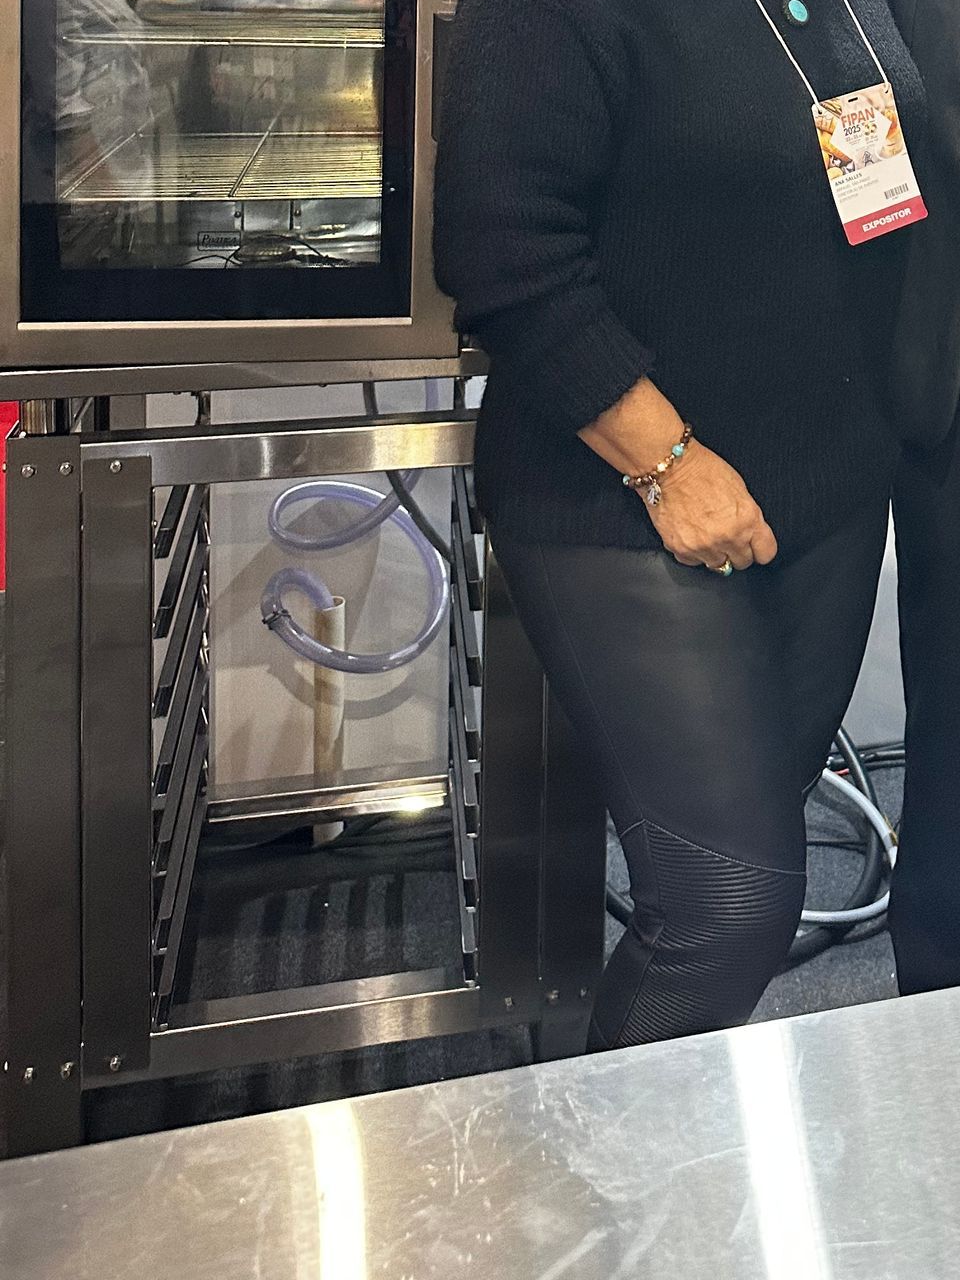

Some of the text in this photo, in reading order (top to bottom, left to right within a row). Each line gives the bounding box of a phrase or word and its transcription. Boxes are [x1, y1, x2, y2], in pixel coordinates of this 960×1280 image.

[841, 107, 875, 129] FIPAN
[843, 124, 861, 137] 2025
[862, 207, 912, 233] EXPOSITOR
